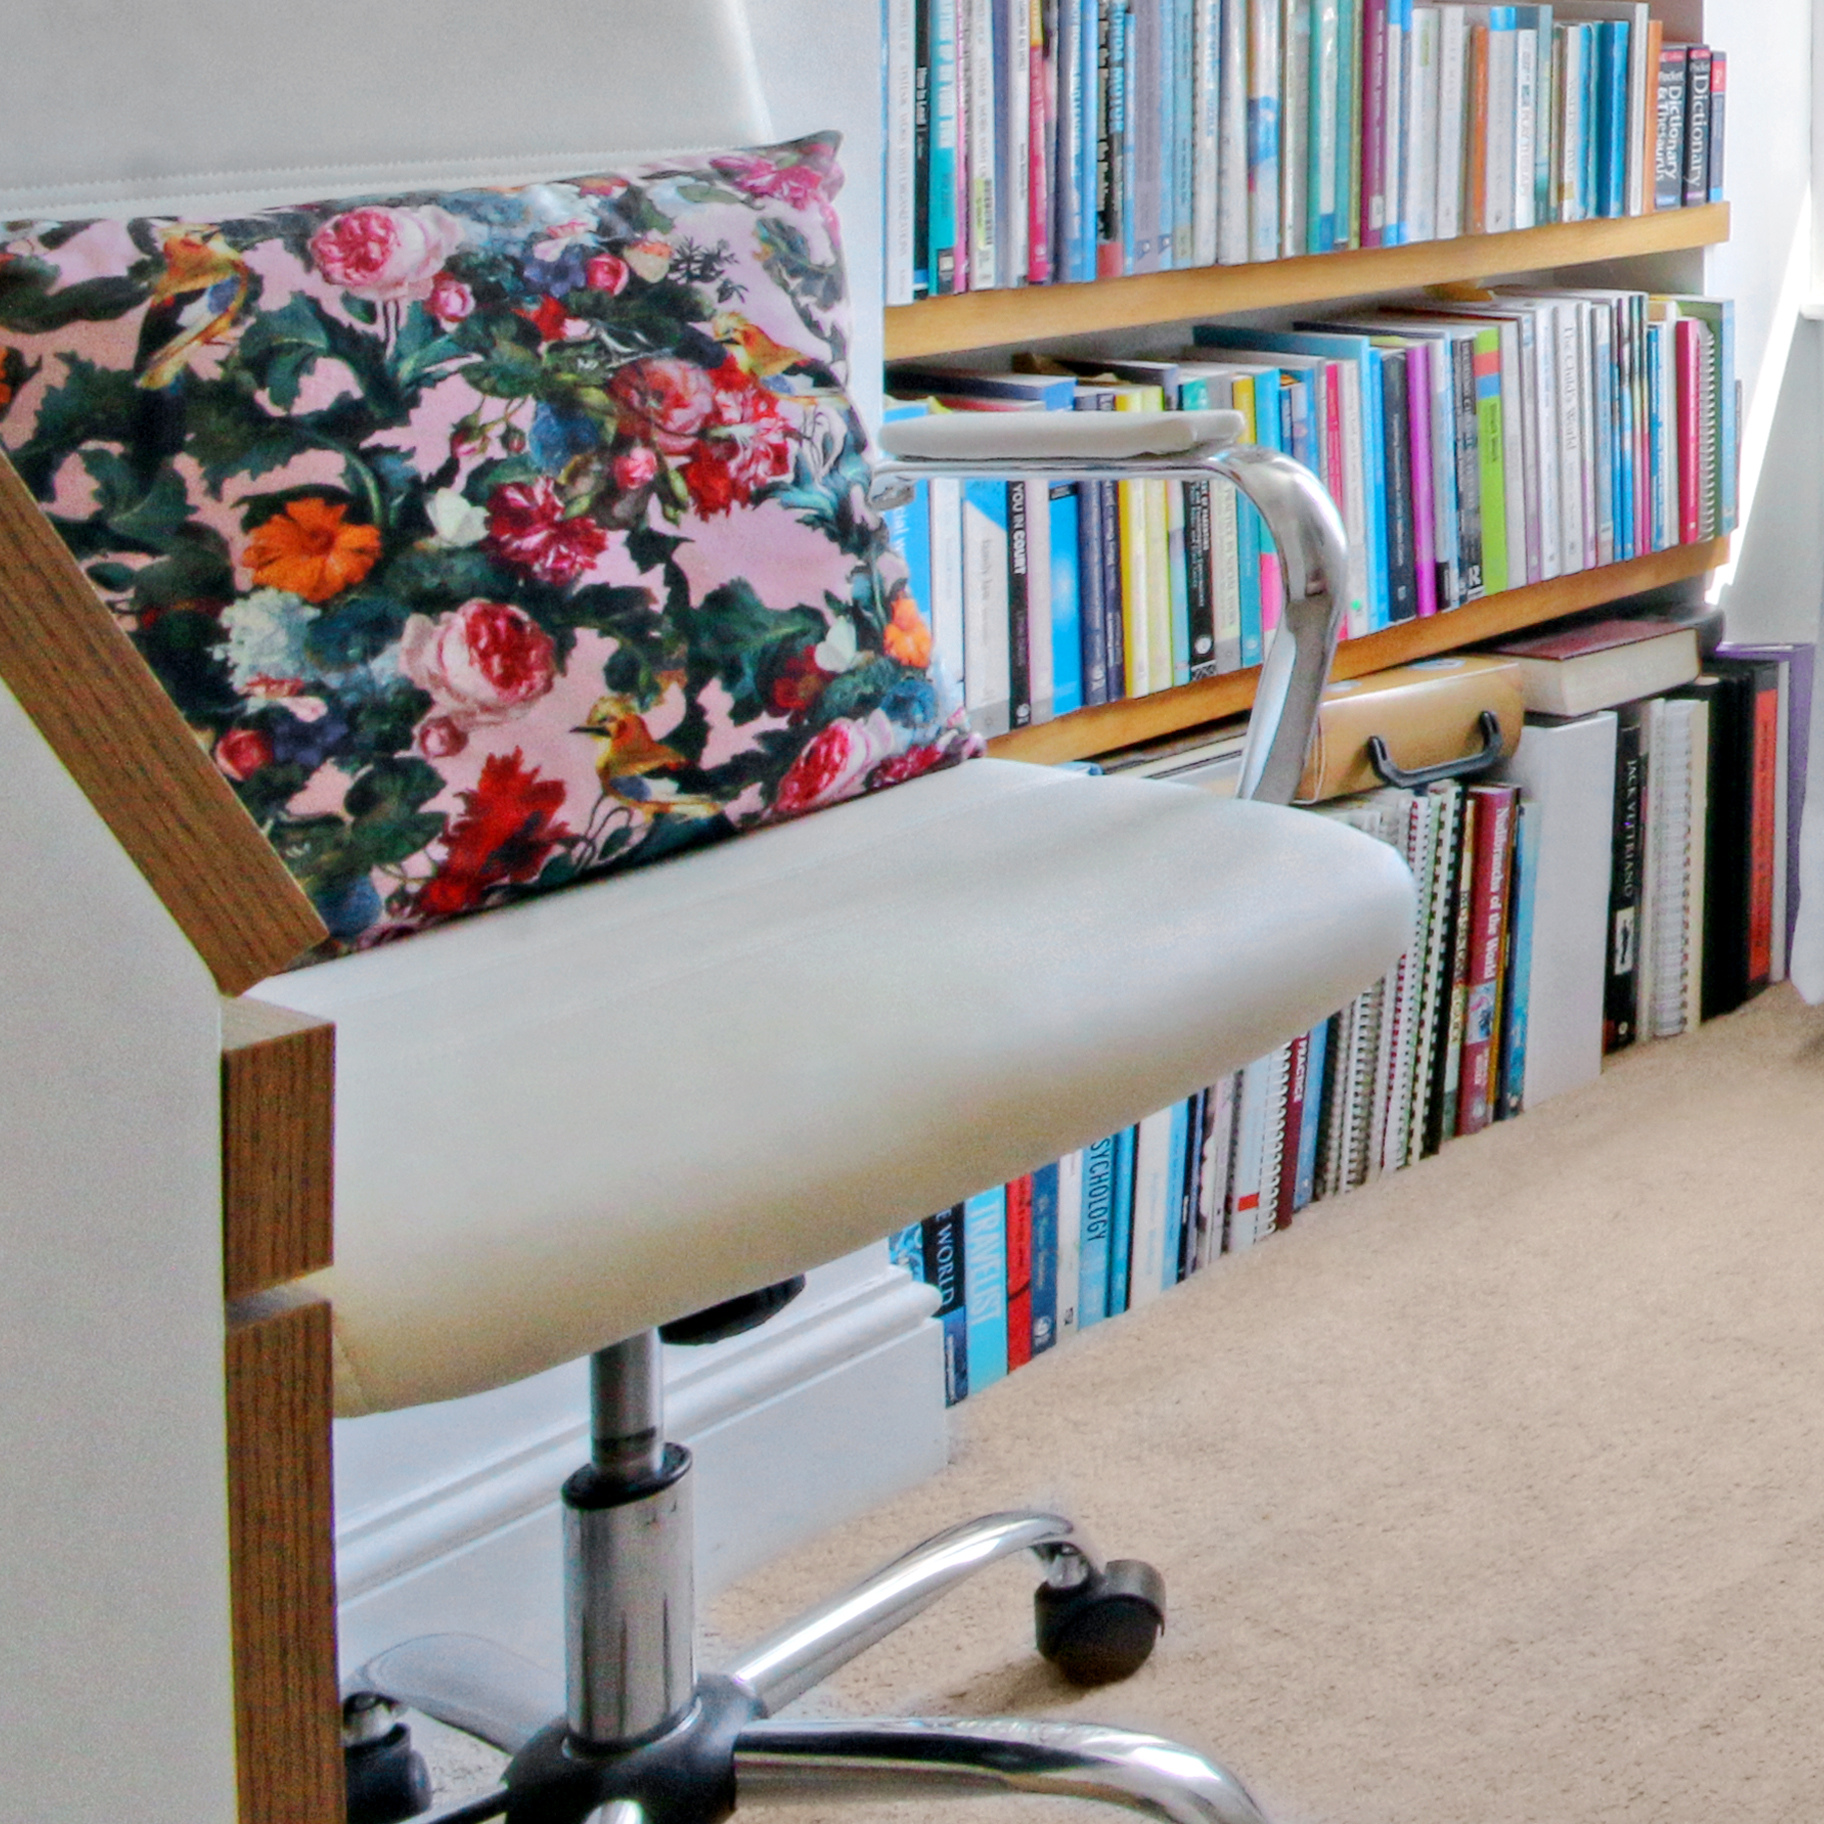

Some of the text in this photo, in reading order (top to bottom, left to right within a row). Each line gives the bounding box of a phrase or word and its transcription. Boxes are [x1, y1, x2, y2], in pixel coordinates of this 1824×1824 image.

[1655, 101, 1668, 182] Thesaurus
[1665, 85, 1682, 179] Dictionary
[1683, 74, 1709, 186] Dictionary
[1011, 484, 1026, 574] YOU IN COURT
[1622, 760, 1638, 899] JACK VETTRIANO
[1482, 807, 1511, 980] Nudibranchs of the World
[1292, 1040, 1307, 1104] PRACTICE
[1086, 1140, 1111, 1242] SYCHOLOGY
[937, 1223, 955, 1304] WORLD
[968, 1202, 1001, 1327] TRAVELIST
